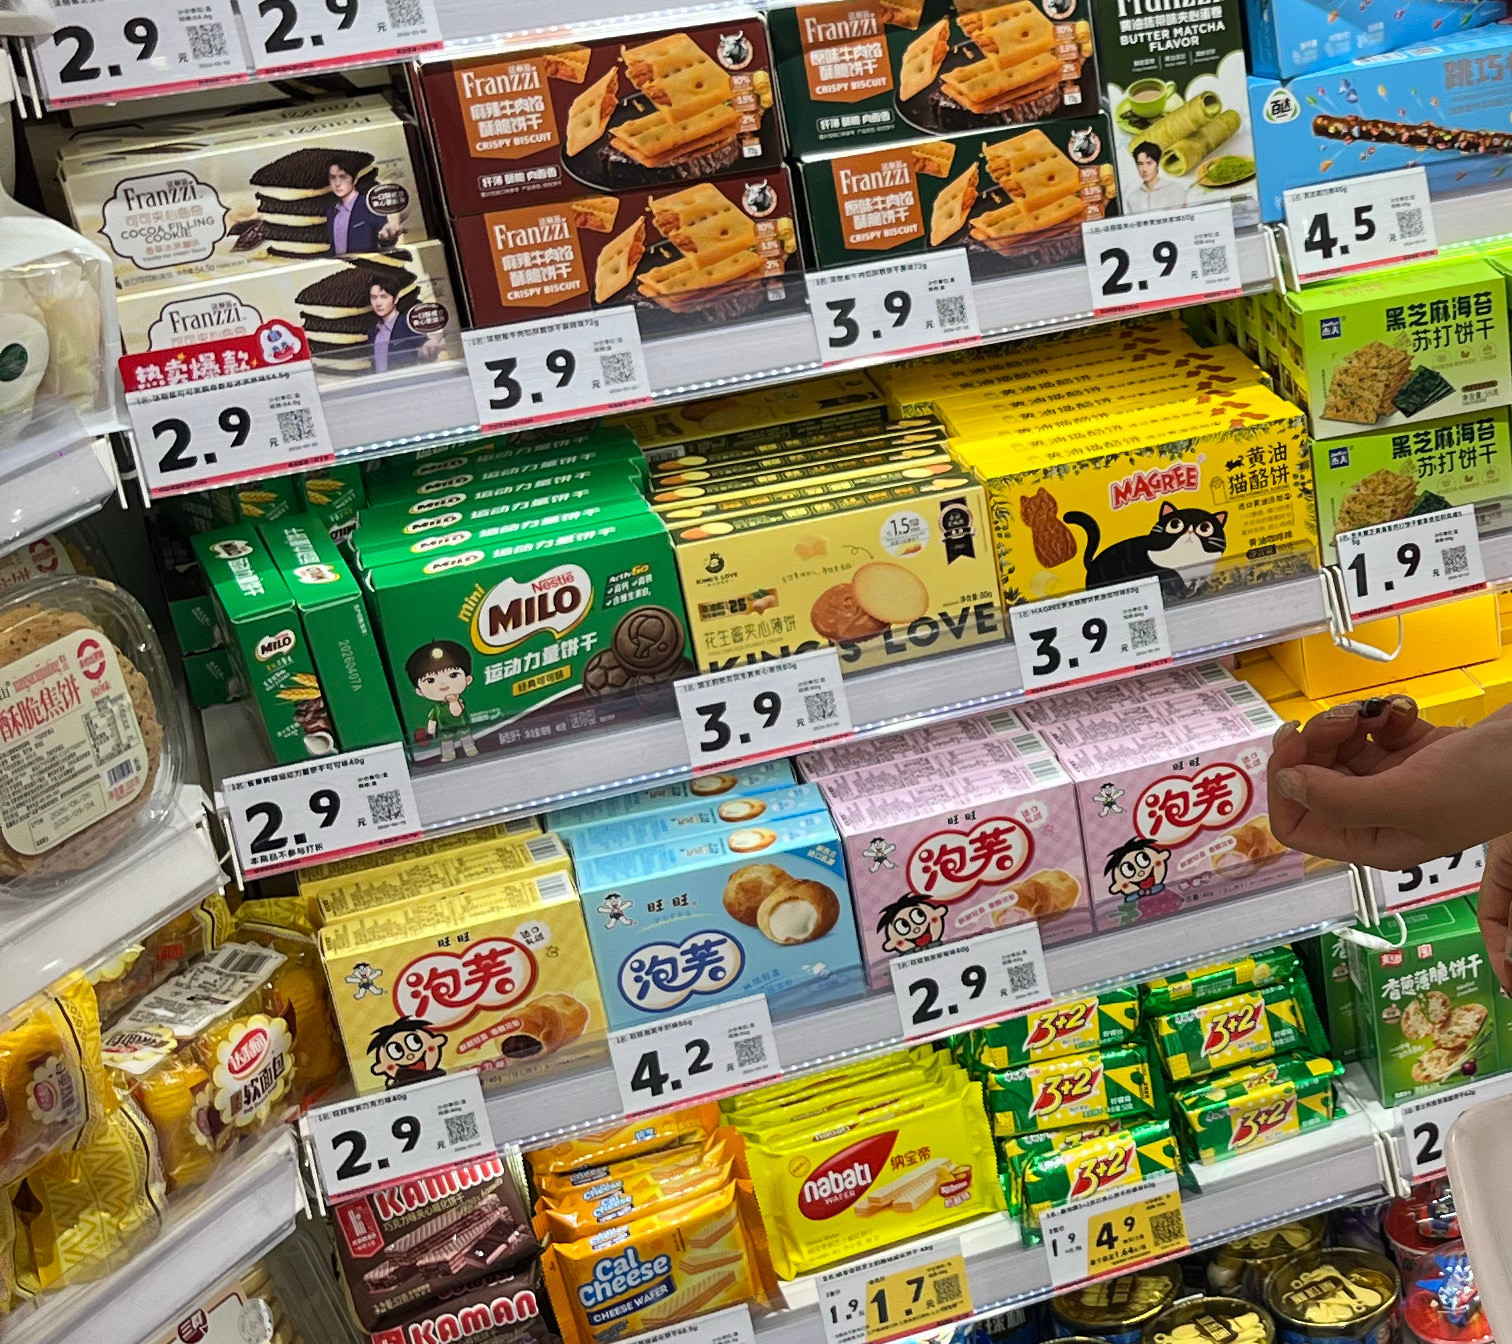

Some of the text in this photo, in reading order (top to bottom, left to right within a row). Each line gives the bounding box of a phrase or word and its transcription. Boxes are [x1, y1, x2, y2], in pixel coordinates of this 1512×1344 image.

[52, 16, 159, 84] 2.9
[1120, 23, 1226, 46] BUTTER MATCHA
[1149, 37, 1200, 52] FLAVOR
[462, 70, 540, 99] Franzzi
[816, 76, 887, 94] CRISPY BISCUIT
[1304, 204, 1377, 259] 4.5
[1101, 240, 1179, 296] 2.9
[827, 291, 912, 349] 3.9
[1386, 293, 1493, 330] 黑芝麻海苔
[1412, 317, 1495, 353] 苏打饼干
[135, 351, 250, 389] 热卖爆款
[484, 348, 577, 410] 3.9
[152, 406, 252, 474] 2.9
[1247, 445, 1287, 463] 黄油
[1110, 463, 1200, 508] MAGREE
[1228, 466, 1289, 489] 猫酪饼
[1347, 542, 1422, 611] 1.9
[459, 583, 487, 622] mini
[489, 585, 582, 637] MILO
[704, 615, 796, 649] 花生酱夹心薄饼
[885, 603, 998, 656] LOVE
[1029, 617, 1109, 676] 3.9
[485, 632, 598, 685] 运动力量饼干
[695, 690, 782, 753] 3.9
[245, 789, 341, 855] 2.9
[918, 830, 1015, 886] 泡芙
[408, 951, 519, 1018] 泡芙
[907, 963, 988, 1025] 2.9
[1381, 953, 1483, 1002] 香葱薄脆饼干
[630, 1038, 714, 1097] 4.2
[1236, 1096, 1295, 1146] 3+2
[332, 1114, 422, 1182] 2.9
[804, 1164, 871, 1205] nabati
[824, 1188, 857, 1205] WAFER
[576, 1260, 672, 1310] Cheese
[593, 1253, 640, 1283] Cal
[593, 1283, 671, 1325] CHEESE WAFER
[830, 1299, 858, 1324] 1.9
[871, 1276, 925, 1324] 1.7
